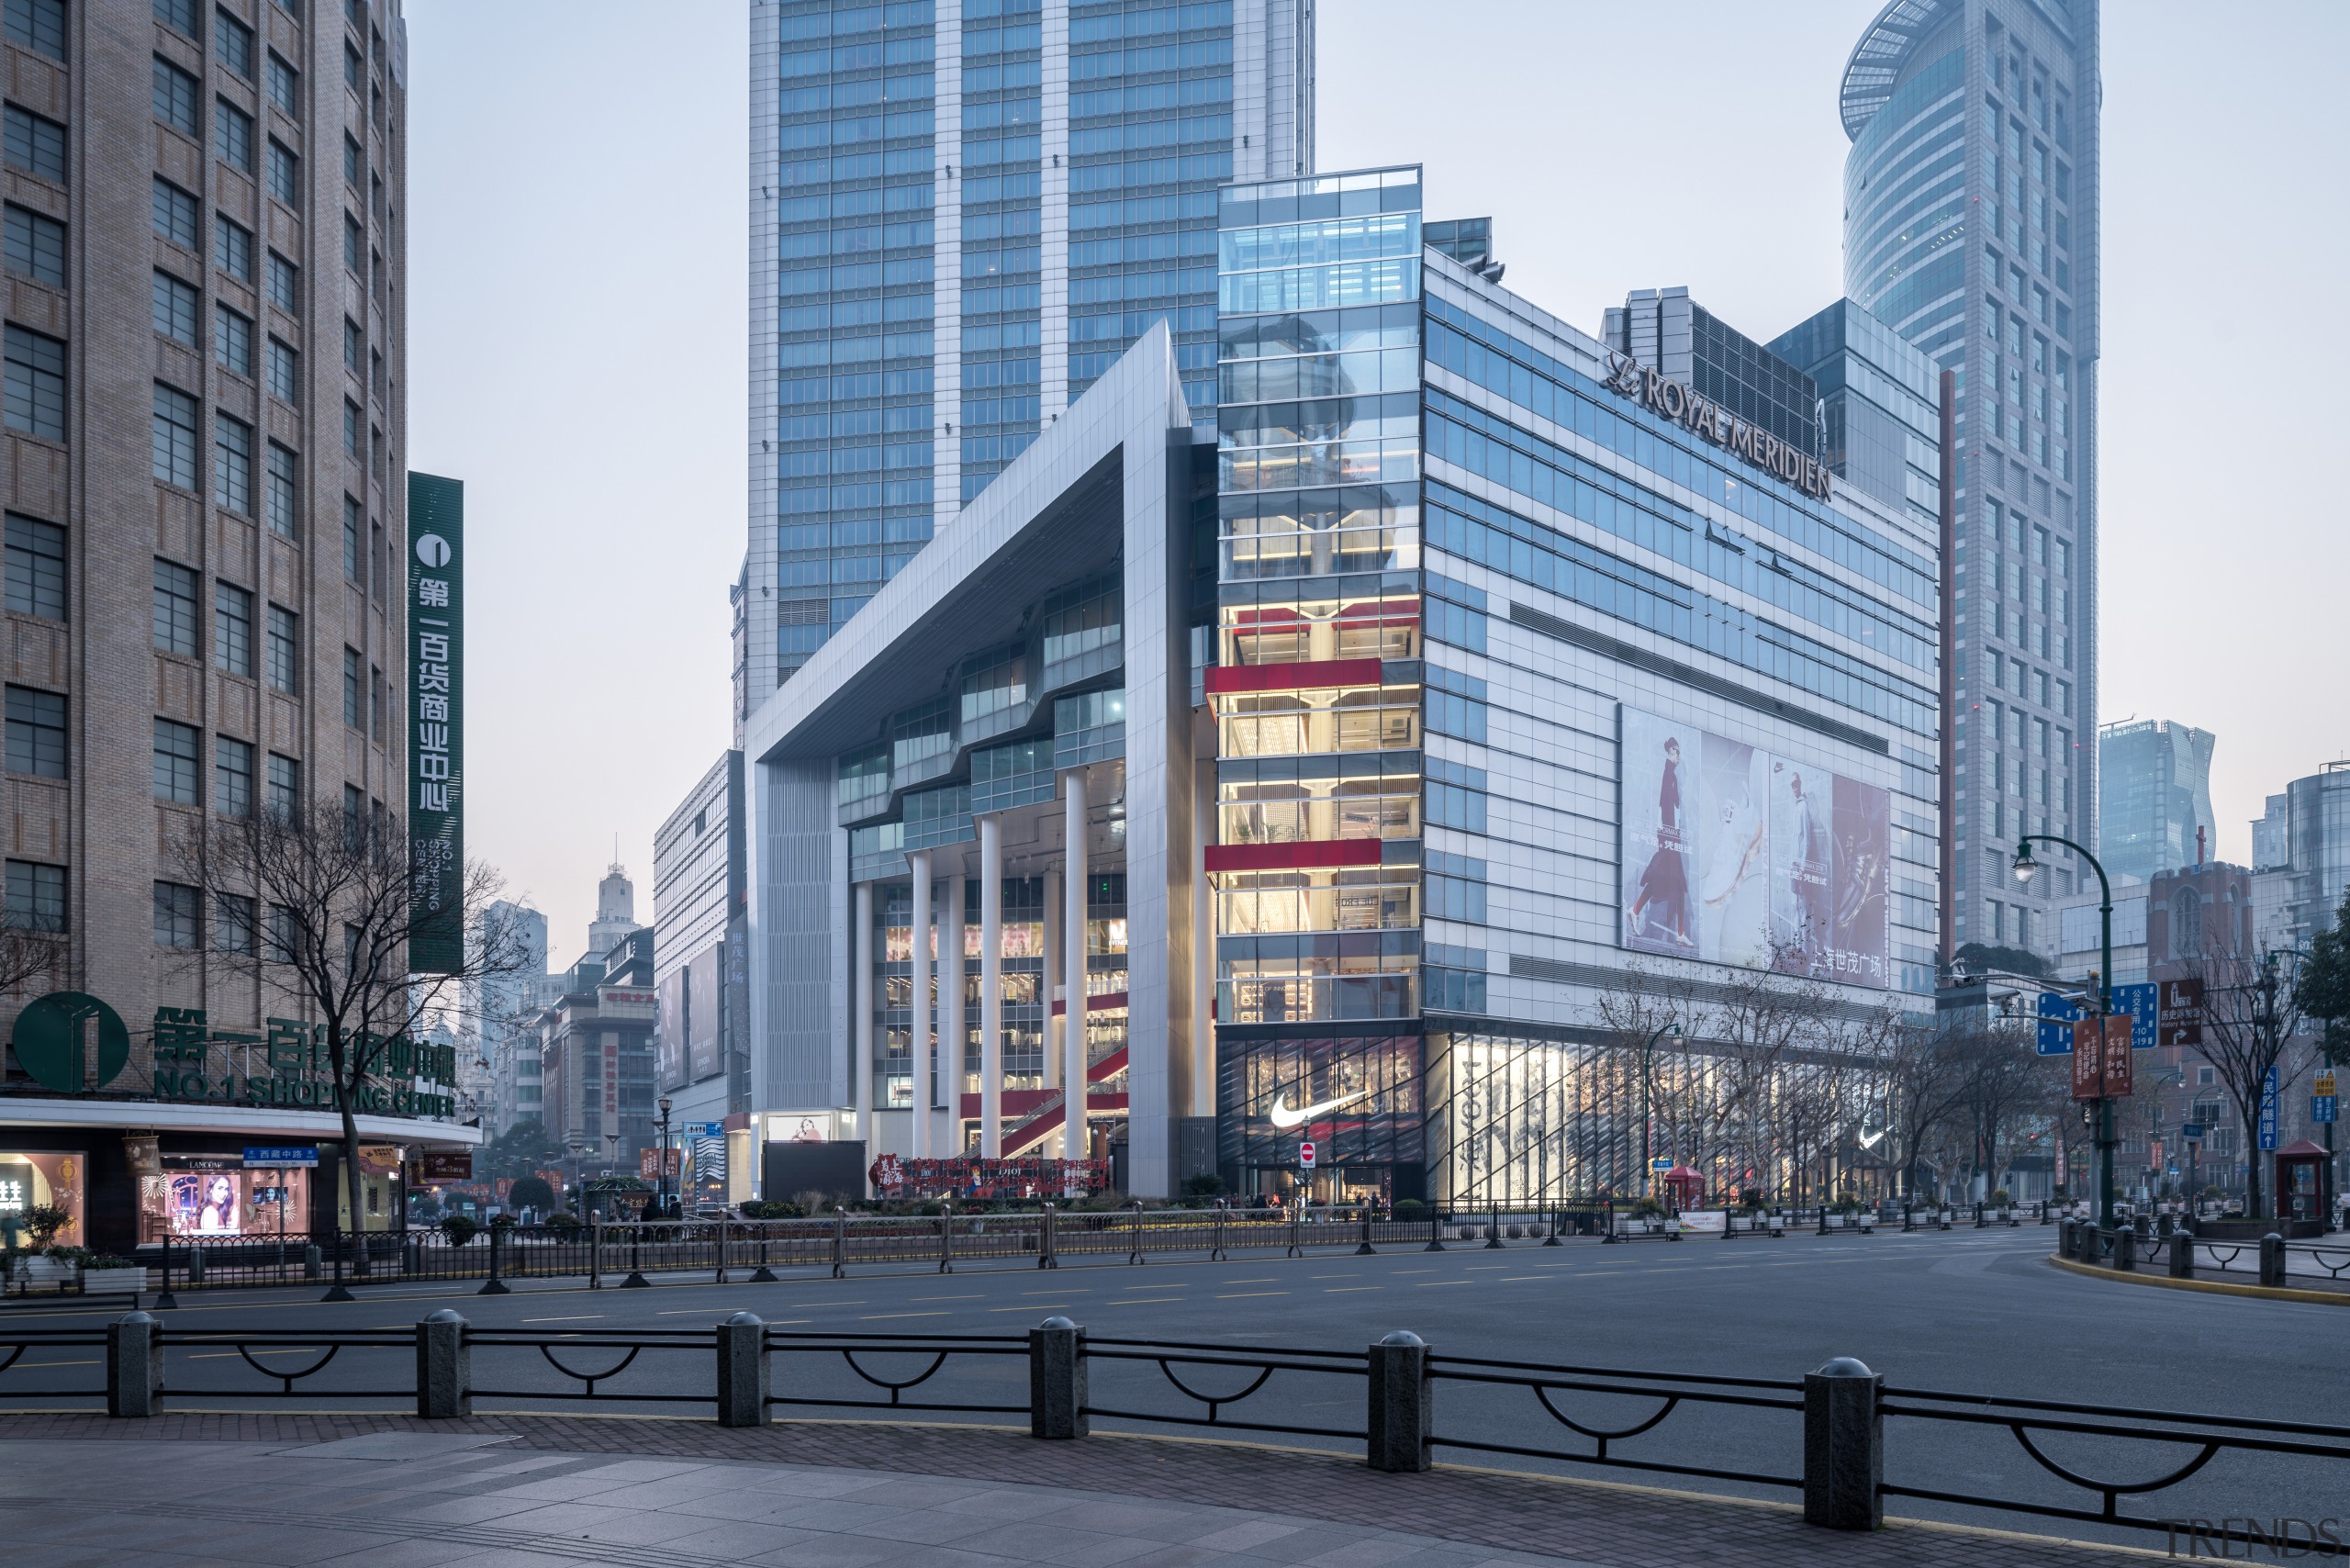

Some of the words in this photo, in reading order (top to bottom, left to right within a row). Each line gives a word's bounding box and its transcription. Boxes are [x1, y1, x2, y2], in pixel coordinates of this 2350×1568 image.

[1606, 351, 1640, 396] Le
[1647, 367, 1726, 444] ROYAL
[1731, 414, 1832, 503] MERIDIEN
[419, 577, 450, 813] 第一百货商业中心
[429, 839, 440, 911] SHOPPING
[732, 932, 744, 983] 世茂广场
[1810, 945, 1881, 978] 上海世茂广场
[2132, 989, 2142, 1024] 公交专用
[154, 1070, 235, 1100] NO.1
[260, 1149, 302, 1159] 西藏中路
[999, 1166, 1022, 1176] Dior
